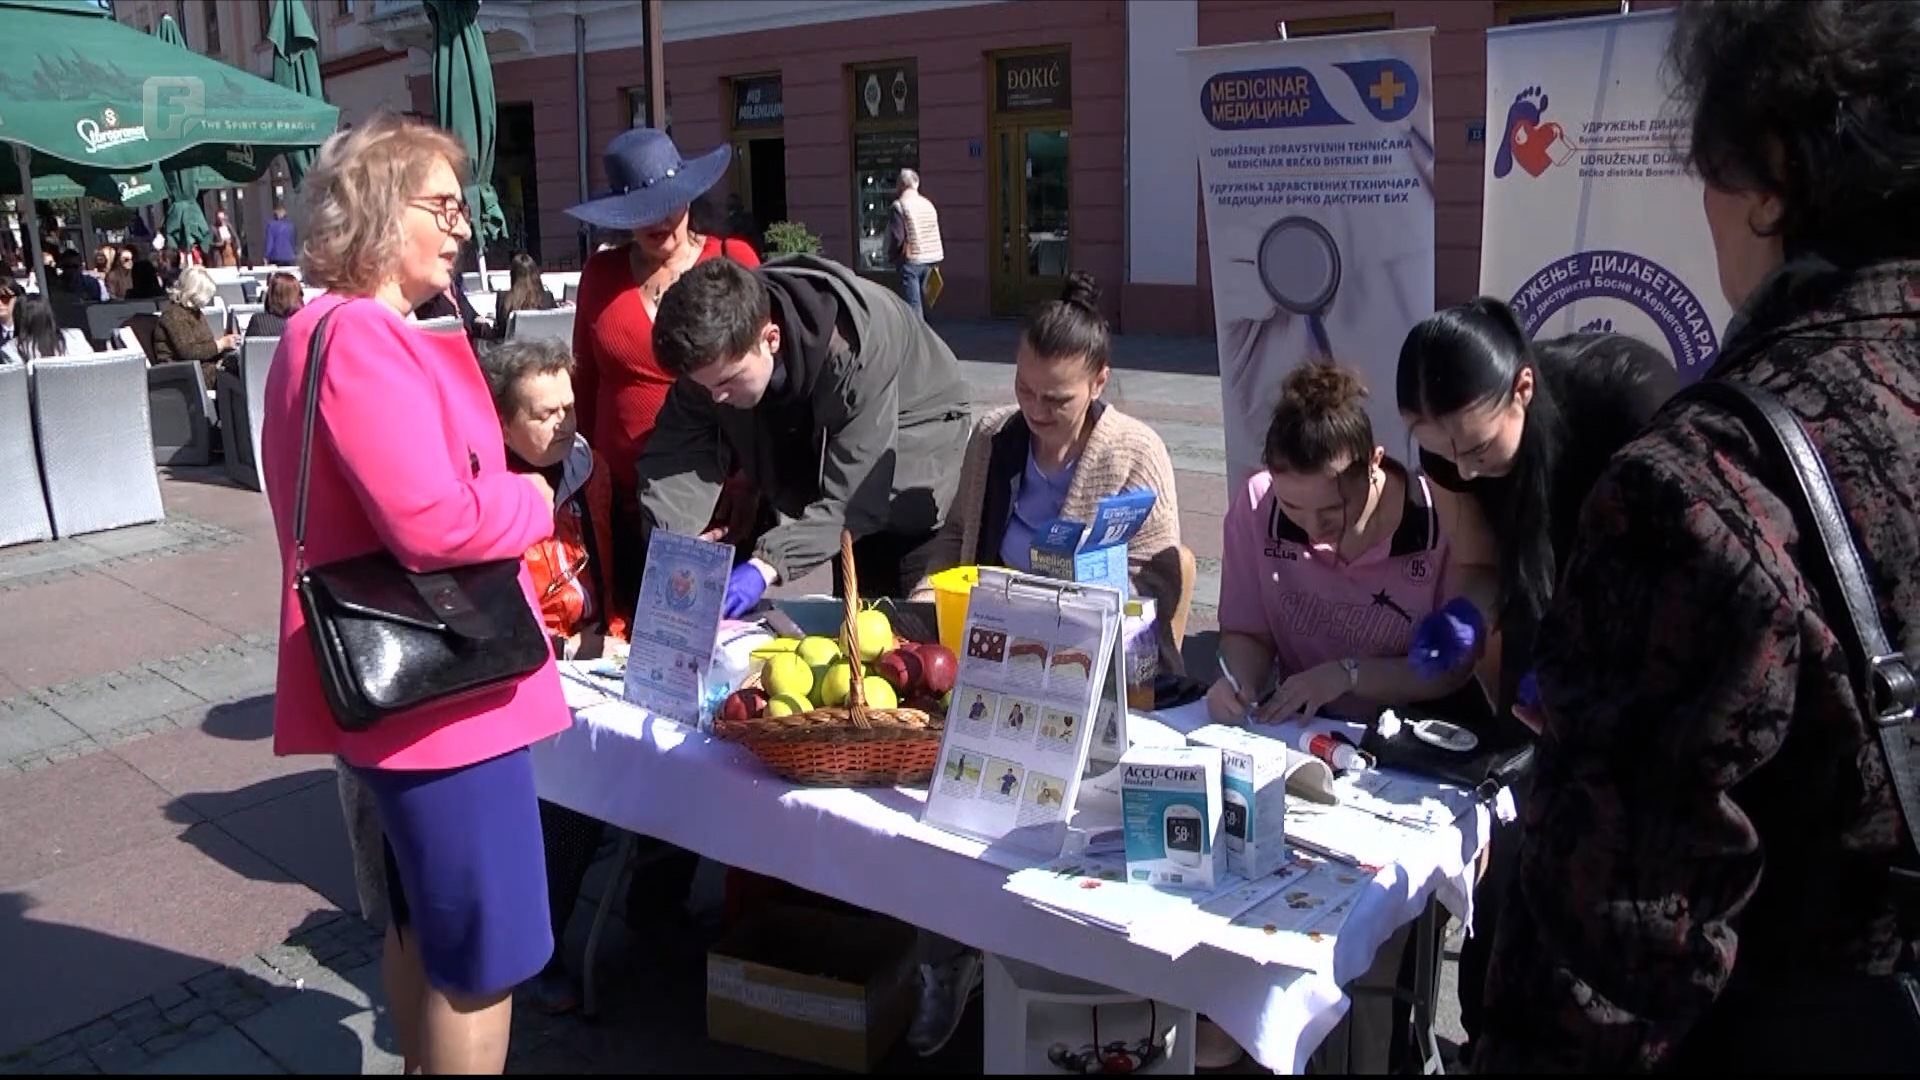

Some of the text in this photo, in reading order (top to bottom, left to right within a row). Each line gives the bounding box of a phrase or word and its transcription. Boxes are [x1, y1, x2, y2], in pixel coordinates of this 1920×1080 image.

[1008, 60, 1060, 90] ĐOKIĆ
[1210, 76, 1309, 102] MEDICINAR
[1211, 98, 1310, 123] МЕДИЦИНАР
[224, 120, 257, 130] SPIRIT
[277, 120, 317, 131] PRAGUE
[1582, 120, 1646, 134] УДРУЖЕЊЕ
[1210, 137, 1413, 158] UDRUŽENJE ZDRAVSTVENIH TEHNIČARA
[1228, 154, 1392, 170] MEDICINAR BRČKO DISTRIKT BIH
[1580, 152, 1649, 166] UDRUŽENJE
[1209, 177, 1420, 195] УДРУЖЕЊЕ ЗДРАВСТВЕНИХ ТЕХНИЧАРА
[1217, 192, 1409, 208] МЕДИЦИНАР БРЧКО ДИСТРИКТ БИХ
[1589, 255, 1713, 360] ДИЈАБЕТИЧАРА
[1536, 278, 1591, 314] дистрикта
[1593, 276, 1633, 294] Босне
[1633, 286, 1642, 298] и
[1641, 290, 1696, 366] Херцеговине
[1411, 560, 1426, 578] 95
[1123, 766, 1199, 782] ACCU-CHEK
[1123, 777, 1155, 788] Instant
